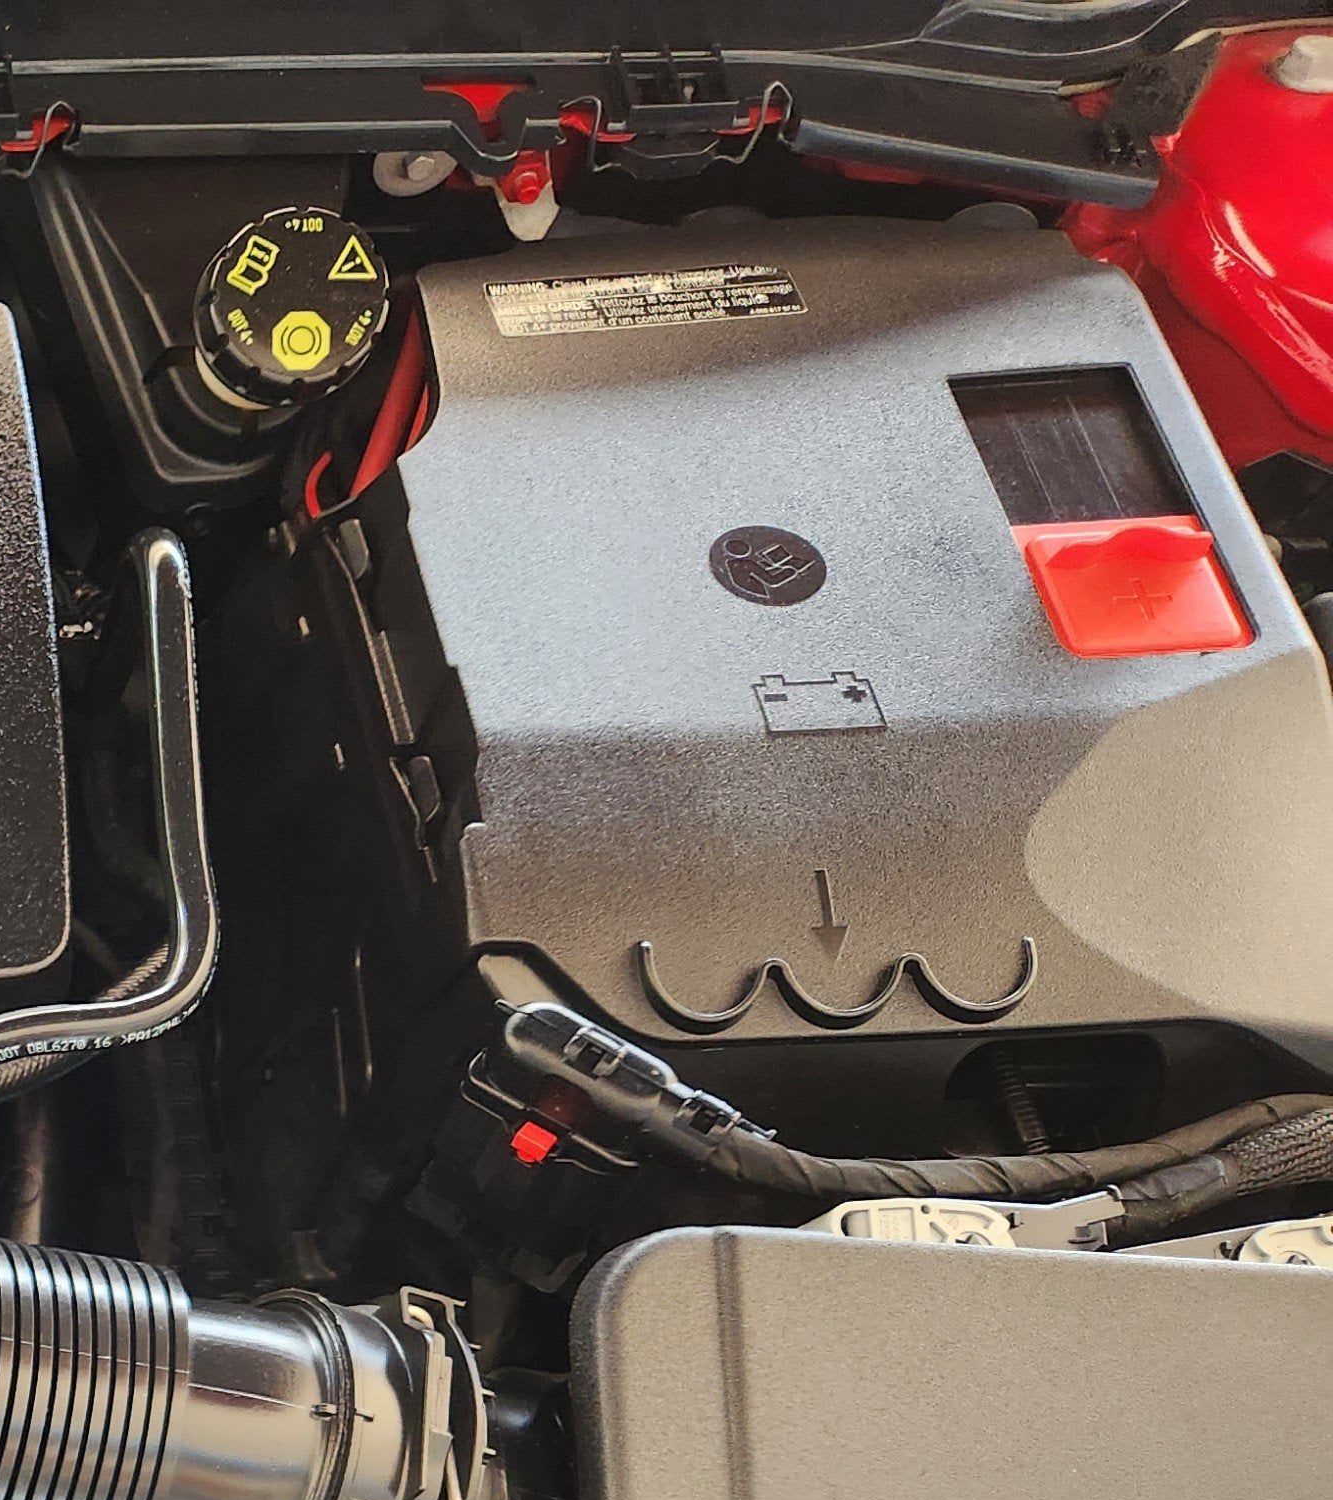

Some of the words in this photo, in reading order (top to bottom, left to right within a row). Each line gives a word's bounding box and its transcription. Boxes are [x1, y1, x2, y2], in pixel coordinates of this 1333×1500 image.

[489, 282, 548, 296] WARNING:
[659, 290, 708, 303] bouchon
[709, 288, 725, 299] de
[715, 298, 730, 309] du
